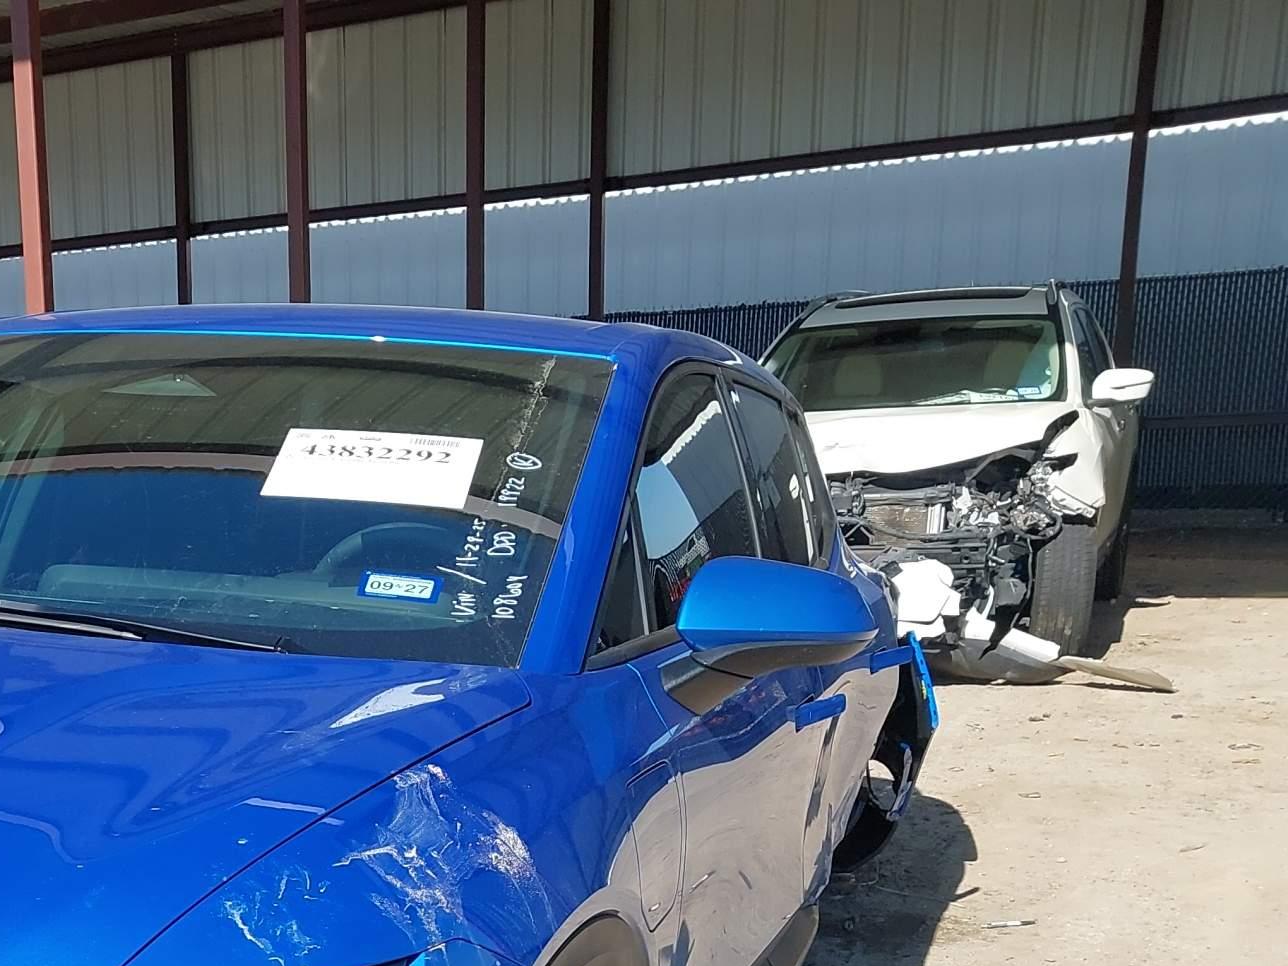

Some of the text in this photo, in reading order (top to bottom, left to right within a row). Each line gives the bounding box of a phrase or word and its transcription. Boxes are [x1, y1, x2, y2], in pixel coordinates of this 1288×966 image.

[301, 443, 452, 464] 43832292
[370, 580, 430, 594] 09 27
